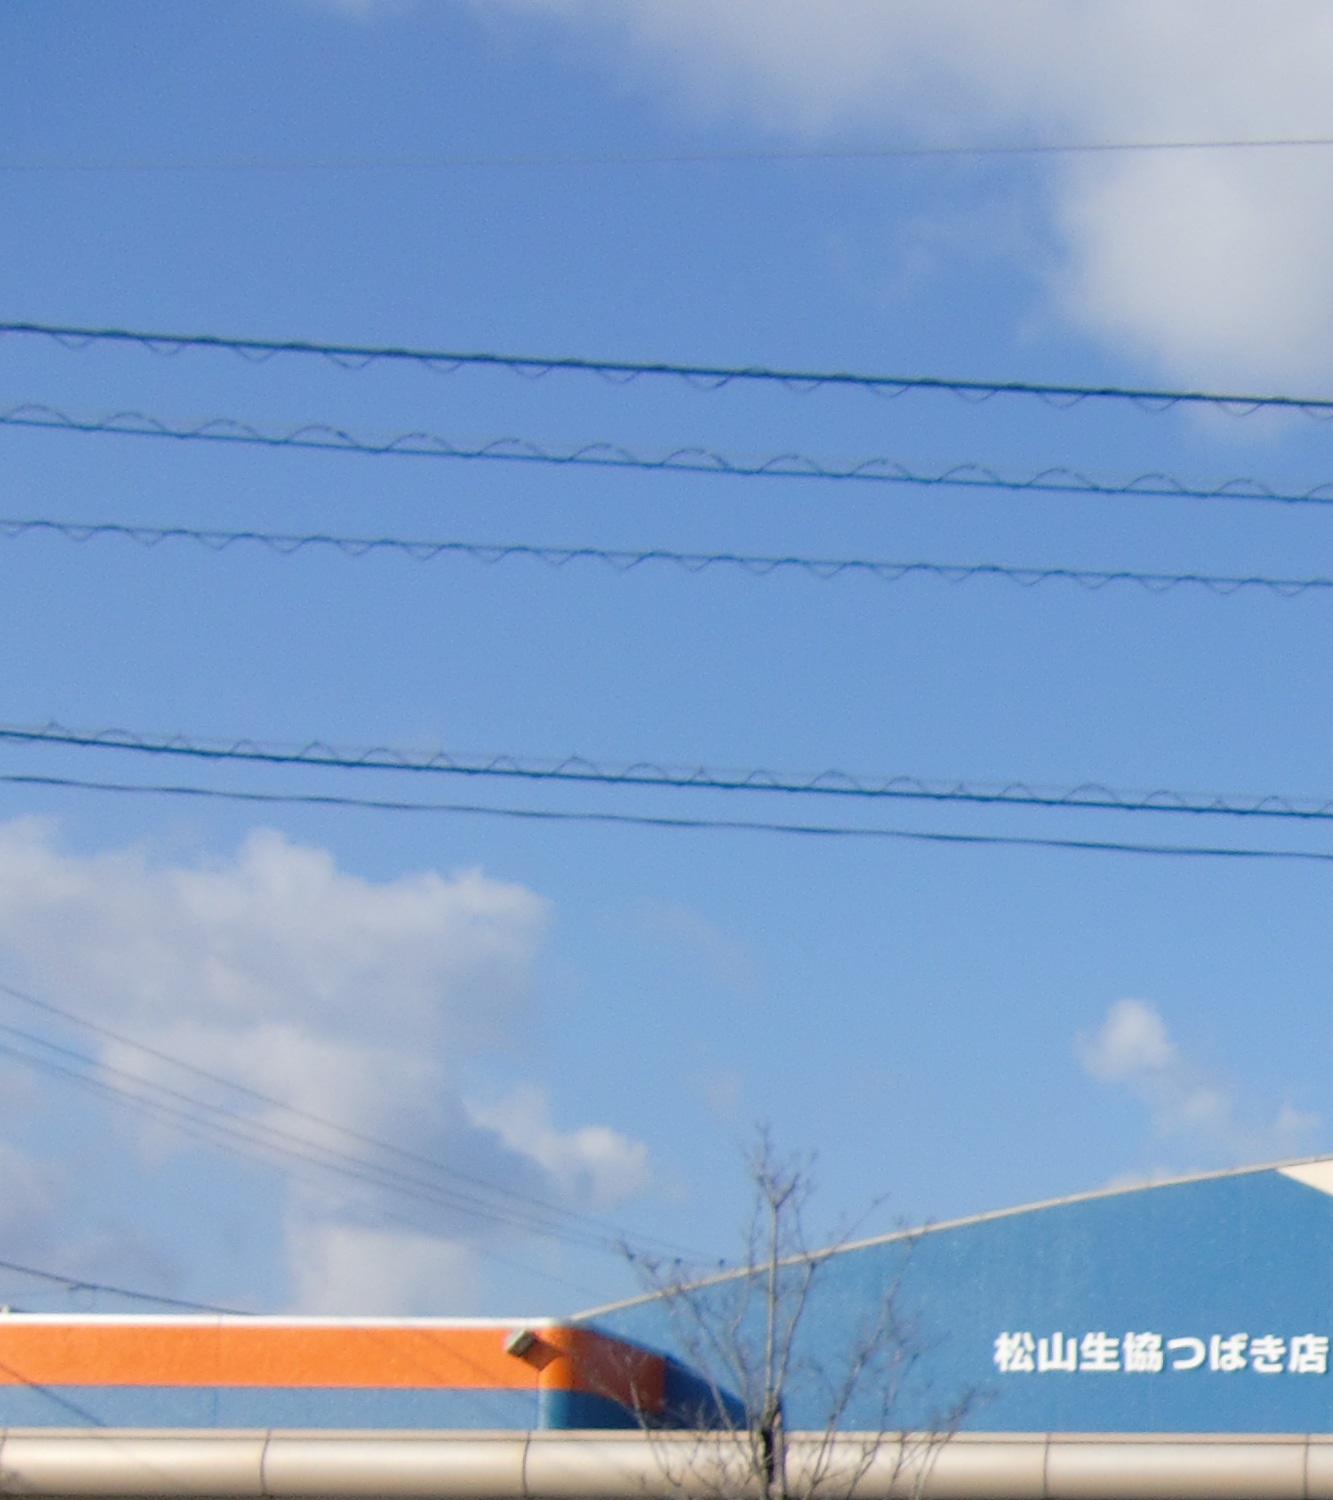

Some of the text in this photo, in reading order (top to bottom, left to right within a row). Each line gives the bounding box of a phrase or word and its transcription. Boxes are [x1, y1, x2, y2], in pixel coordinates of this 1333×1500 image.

[993, 1331, 1329, 1374] 松山生協つばき店
